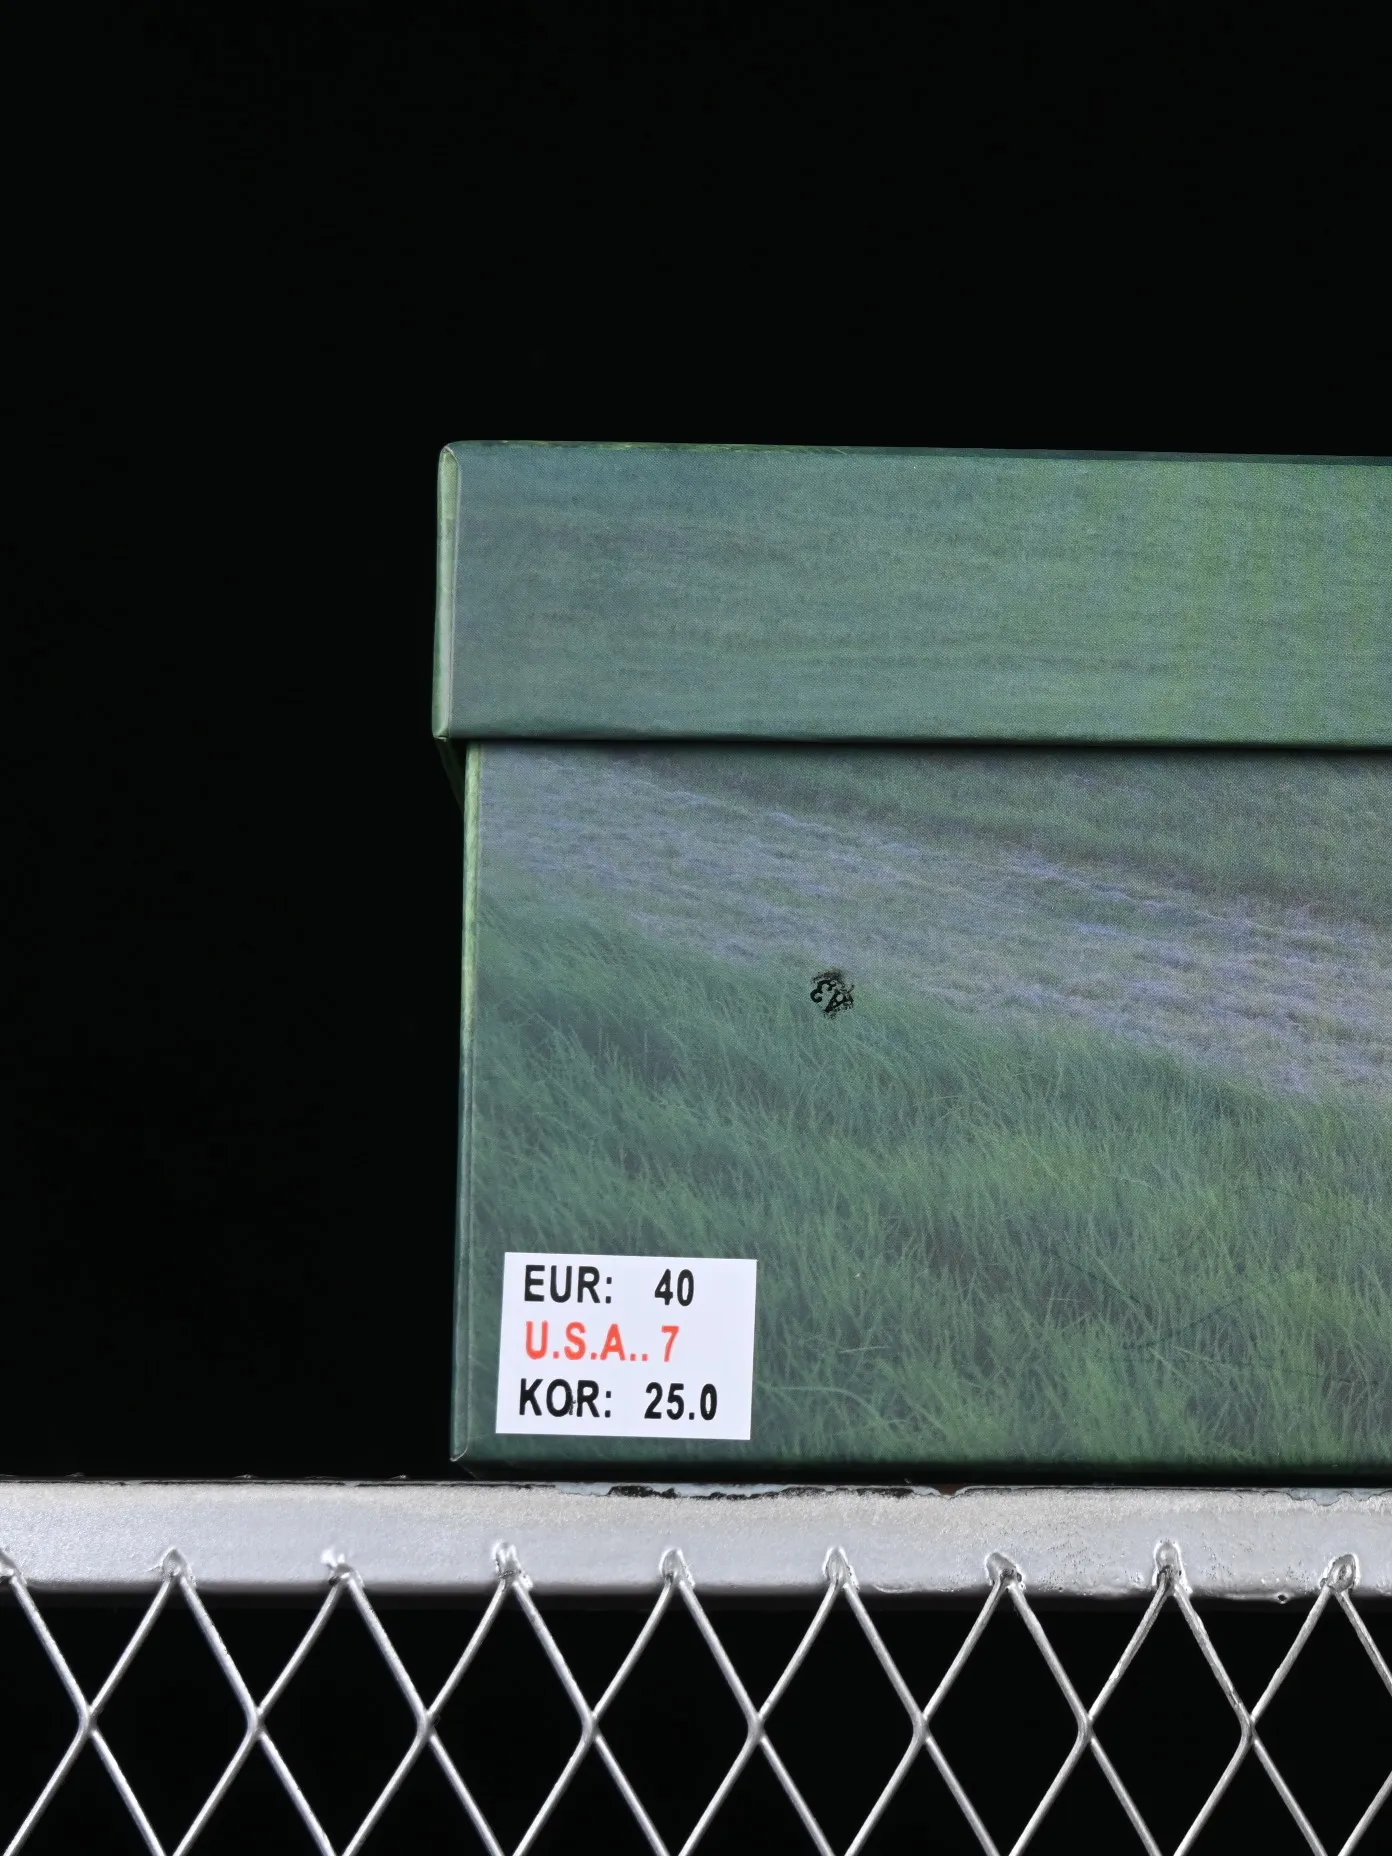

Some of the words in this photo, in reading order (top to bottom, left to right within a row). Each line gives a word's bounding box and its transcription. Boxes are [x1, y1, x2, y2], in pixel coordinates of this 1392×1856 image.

[810, 978, 854, 1014] A3
[524, 1264, 613, 1304] EUR:
[654, 1268, 695, 1307] 40
[661, 1325, 680, 1363] 7
[519, 1377, 612, 1419] KOR:
[643, 1381, 718, 1421] 25.0
